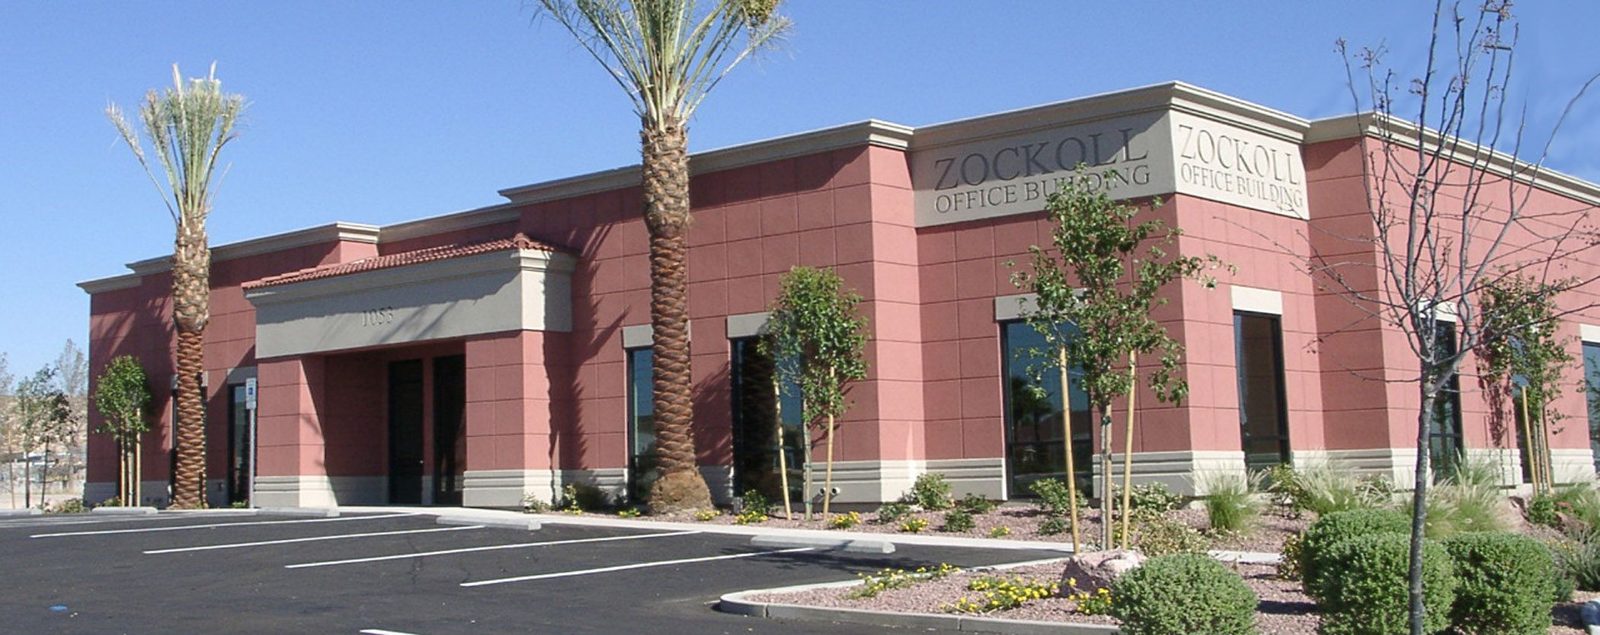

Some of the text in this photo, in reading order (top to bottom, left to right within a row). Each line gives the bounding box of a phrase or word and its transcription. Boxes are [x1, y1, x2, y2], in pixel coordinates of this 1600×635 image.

[934, 128, 1149, 191] ZOCKOLL
[1178, 124, 1300, 185] ZOCKOLL
[935, 185, 1017, 213] OFFICE
[1181, 162, 1303, 208] OFFICE BUILDING
[362, 306, 393, 327] 1053
